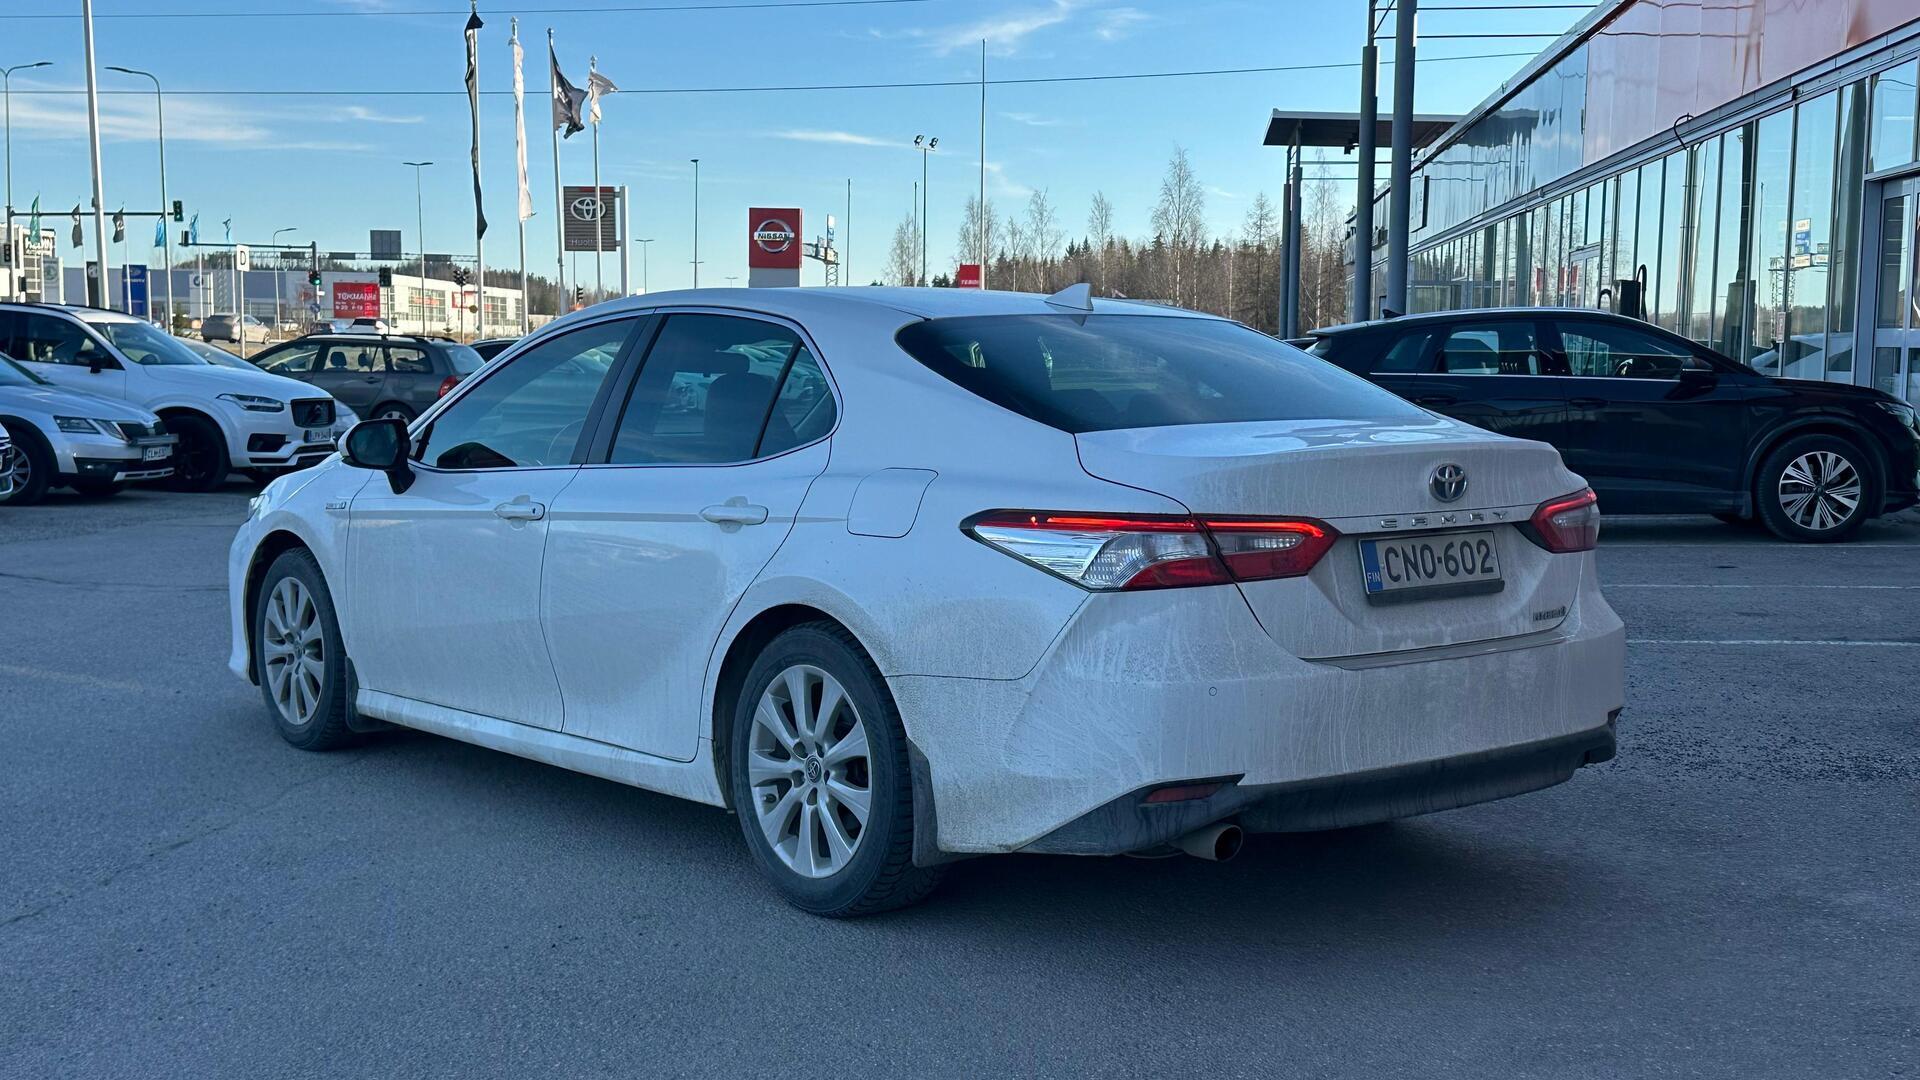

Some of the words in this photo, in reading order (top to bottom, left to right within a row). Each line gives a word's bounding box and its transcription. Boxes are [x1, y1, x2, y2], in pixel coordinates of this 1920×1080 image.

[757, 232, 790, 240] NISSAN
[240, 250, 247, 265] D
[1380, 511, 1509, 528] CAMRY
[1384, 538, 1495, 583] CNO-602
[1367, 571, 1382, 584] FIN
